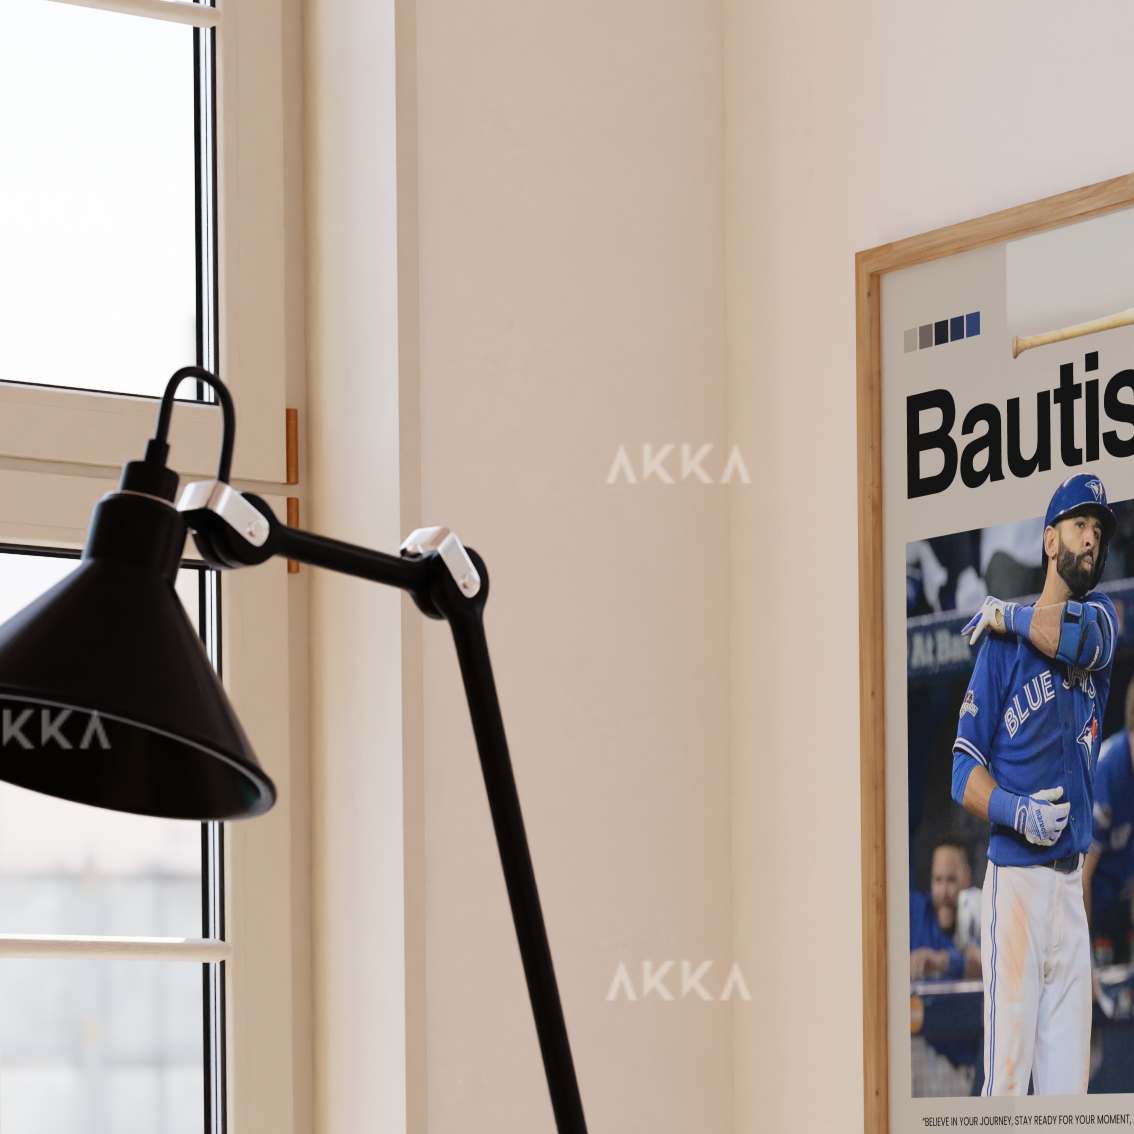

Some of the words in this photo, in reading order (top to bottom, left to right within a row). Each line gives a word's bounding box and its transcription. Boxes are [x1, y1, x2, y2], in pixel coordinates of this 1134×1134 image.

[1004, 669, 1055, 739] BLUE
[922, 1116, 949, 1126] “BELIEVE
[950, 1116, 957, 1125] IN
[959, 1116, 978, 1126] YOUR
[979, 1115, 1014, 1126] JOURNEY,
[1014, 1115, 1032, 1125] STAY
[1034, 1115, 1057, 1125] READY
[1058, 1114, 1073, 1124] FOR
[1074, 1114, 1095, 1124] YOUR
[1096, 1113, 1132, 1125] MOMENT,
